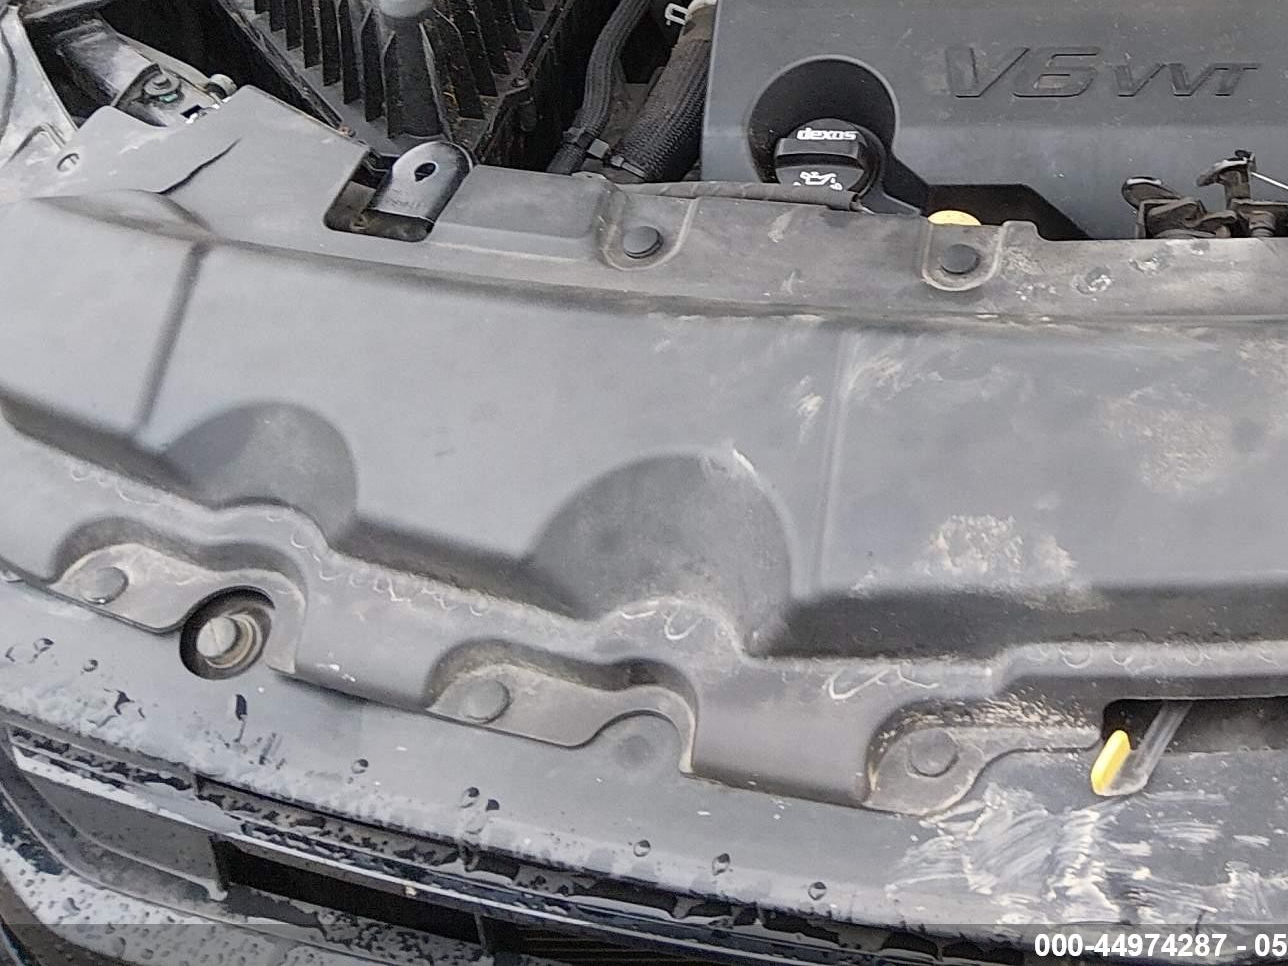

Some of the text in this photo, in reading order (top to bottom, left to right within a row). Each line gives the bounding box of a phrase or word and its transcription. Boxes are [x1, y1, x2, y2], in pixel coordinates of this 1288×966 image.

[945, 46, 1262, 98] V6 VVT
[796, 127, 860, 141] dexos
